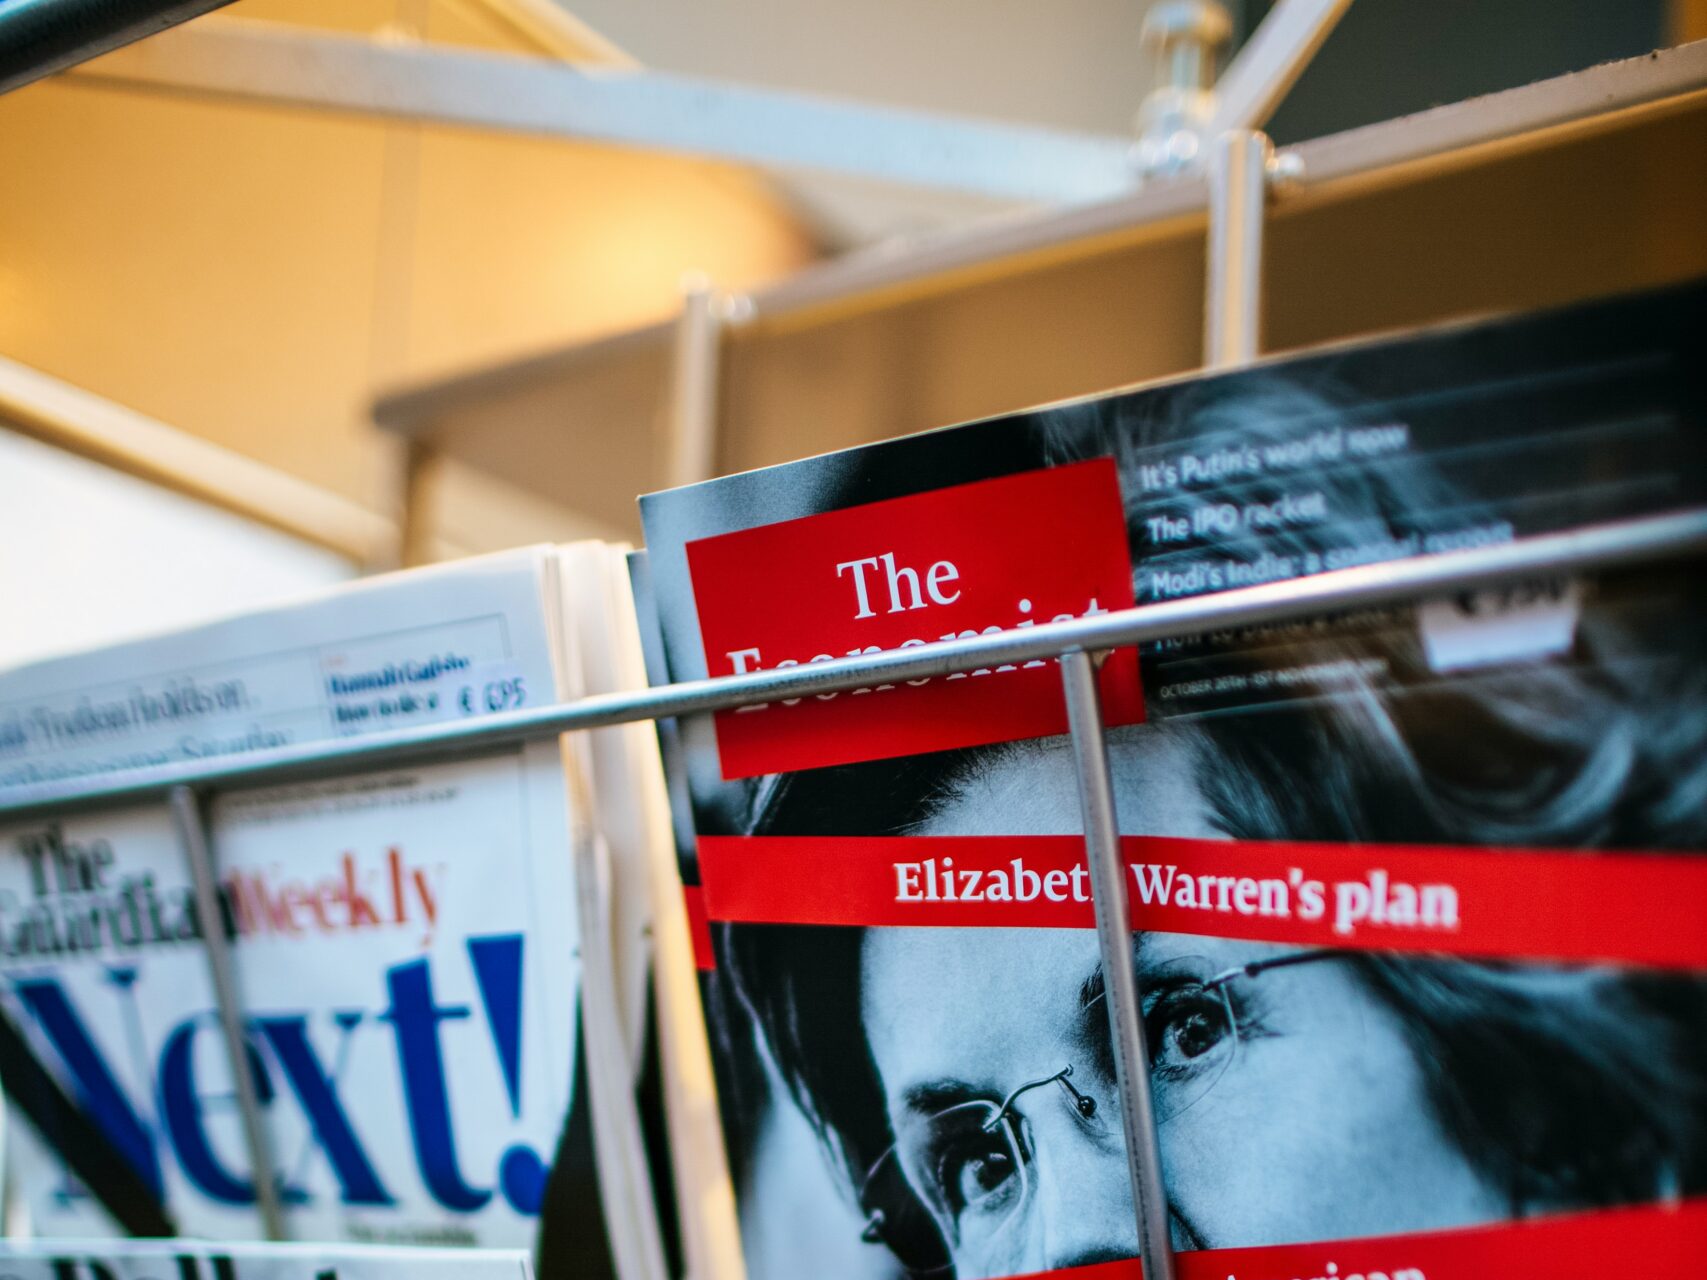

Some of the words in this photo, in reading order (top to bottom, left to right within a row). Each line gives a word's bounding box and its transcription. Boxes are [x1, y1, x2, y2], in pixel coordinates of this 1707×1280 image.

[1147, 514, 1189, 544] The
[1193, 502, 1240, 536] IPO
[836, 550, 961, 620] The
[226, 846, 445, 948] Weekly
[893, 856, 1095, 904] Elizabet
[1131, 863, 1328, 922] Warren's
[1335, 870, 1460, 935] plan
